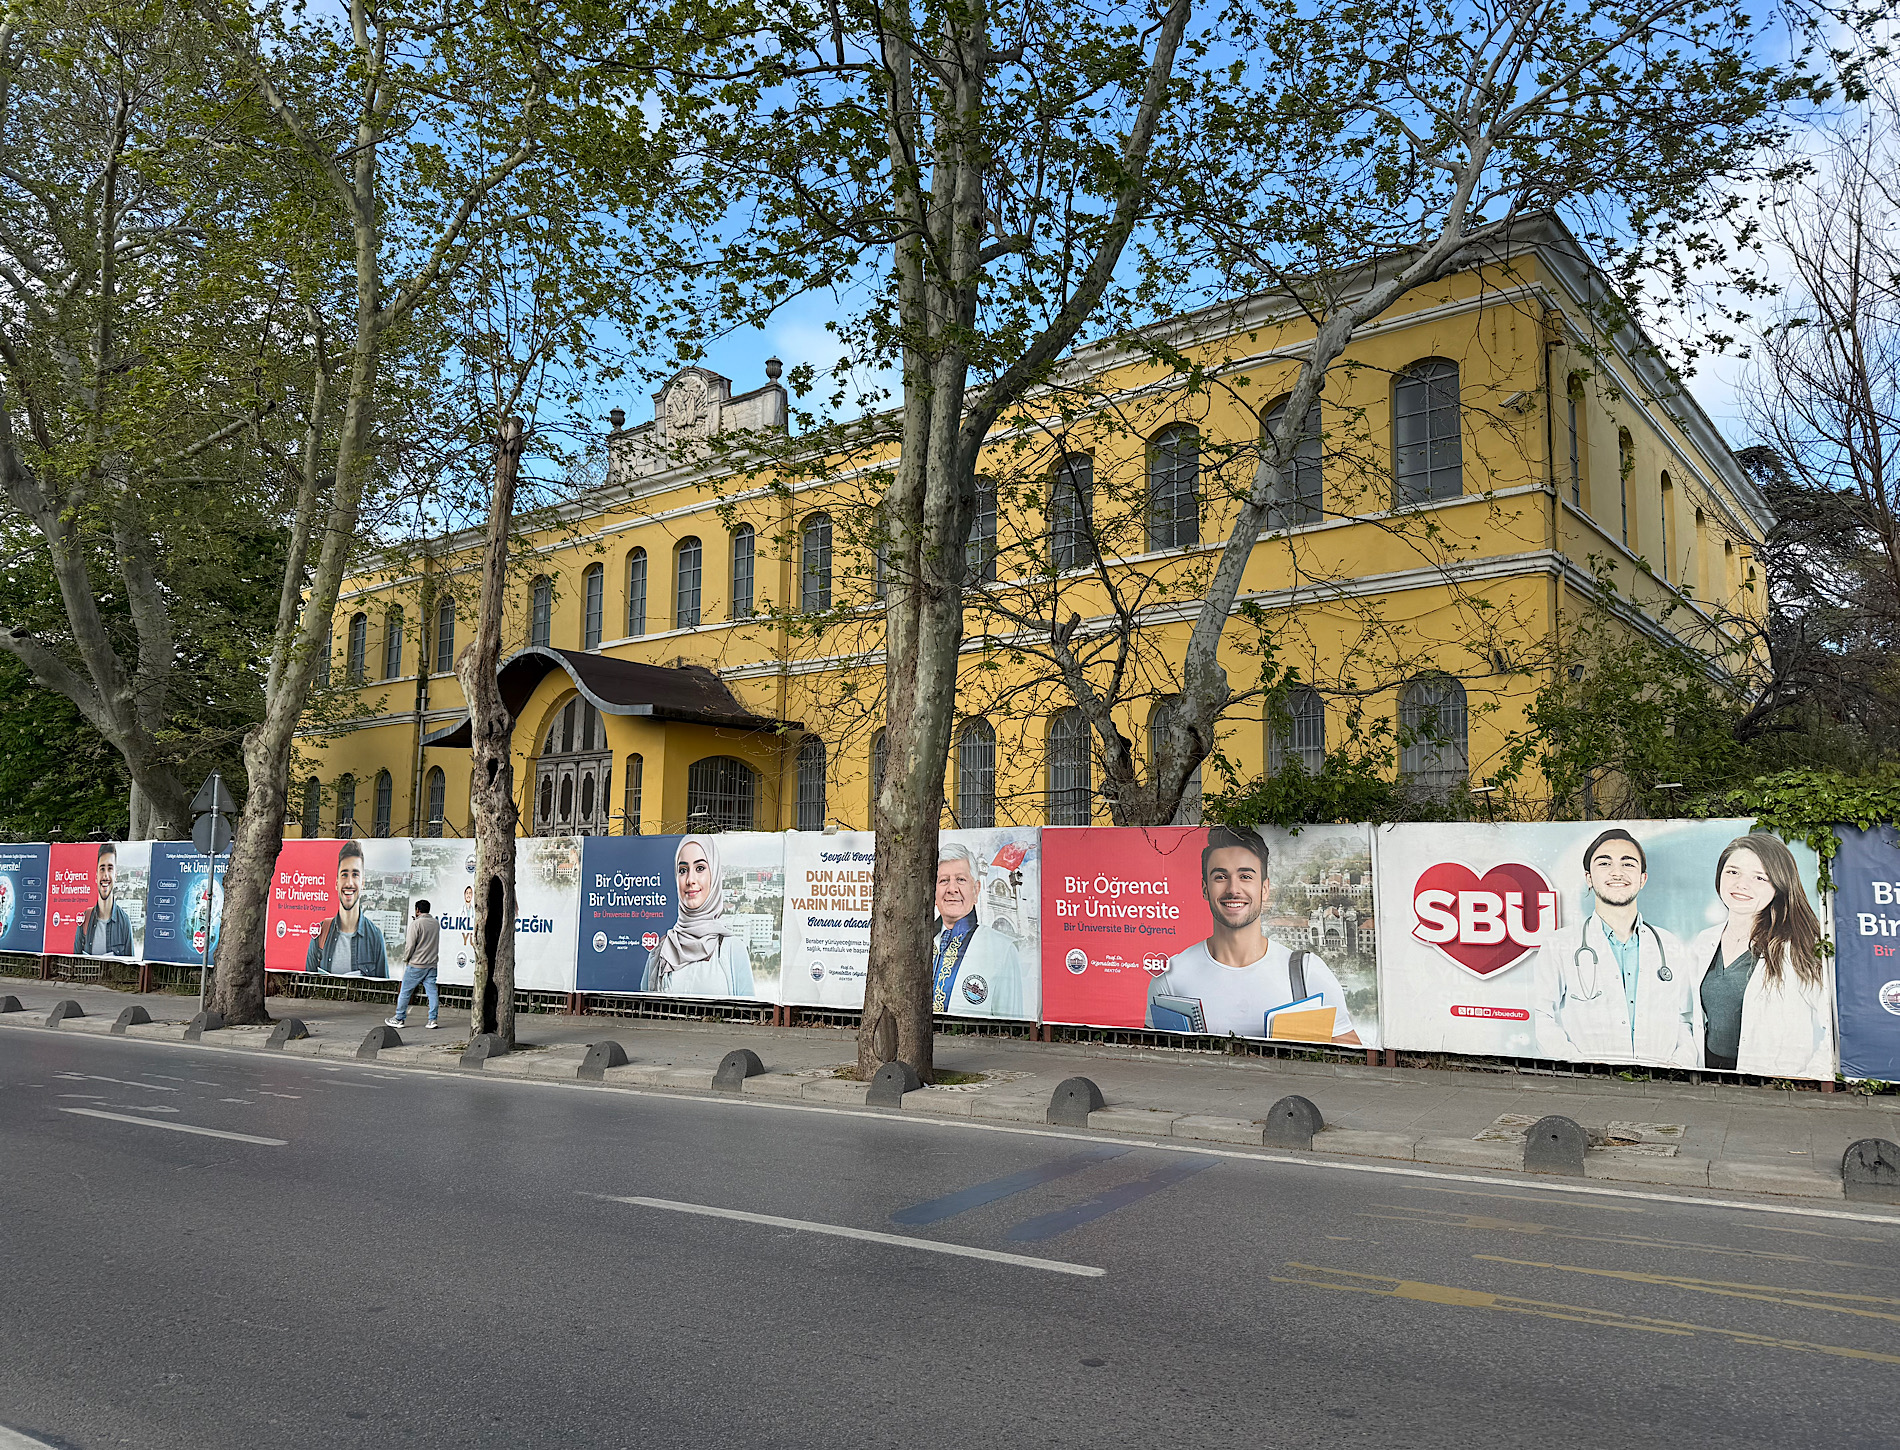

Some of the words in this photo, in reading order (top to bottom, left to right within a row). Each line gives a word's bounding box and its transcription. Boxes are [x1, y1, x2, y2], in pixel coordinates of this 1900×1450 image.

[820, 851, 851, 864] Sevgili
[180, 862, 192, 873] Tek
[280, 872, 291, 884] Bir
[293, 870, 325, 888] Öğrenci
[595, 873, 611, 888] Bir
[613, 870, 661, 891] Öğrenci
[806, 870, 833, 883] DÜN
[51, 884, 60, 894] Bir
[811, 884, 856, 898] BUGÜN
[1064, 876, 1089, 894] Bir
[1093, 872, 1170, 899] Öğrenci
[275, 888, 286, 900] Bir
[288, 886, 329, 902] Üniversite
[589, 892, 605, 907] Bir
[607, 889, 667, 907] Üniversite
[791, 897, 828, 911] YARIN
[1055, 899, 1080, 917] Bir
[1084, 896, 1180, 919] Üniversite
[593, 910, 601, 918] Bir
[602, 909, 630, 918] Üniversite
[631, 910, 640, 918] Bir
[640, 909, 664, 920] Öğrenci
[807, 916, 842, 928] Gururu
[1063, 922, 1075, 932] Bir
[1077, 921, 1122, 933] Üniversite
[1123, 924, 1136, 934] Bir
[1138, 923, 1176, 936] Öğrenci
[1857, 912, 1900, 937] Bir
[1873, 944, 1896, 957] Bir
